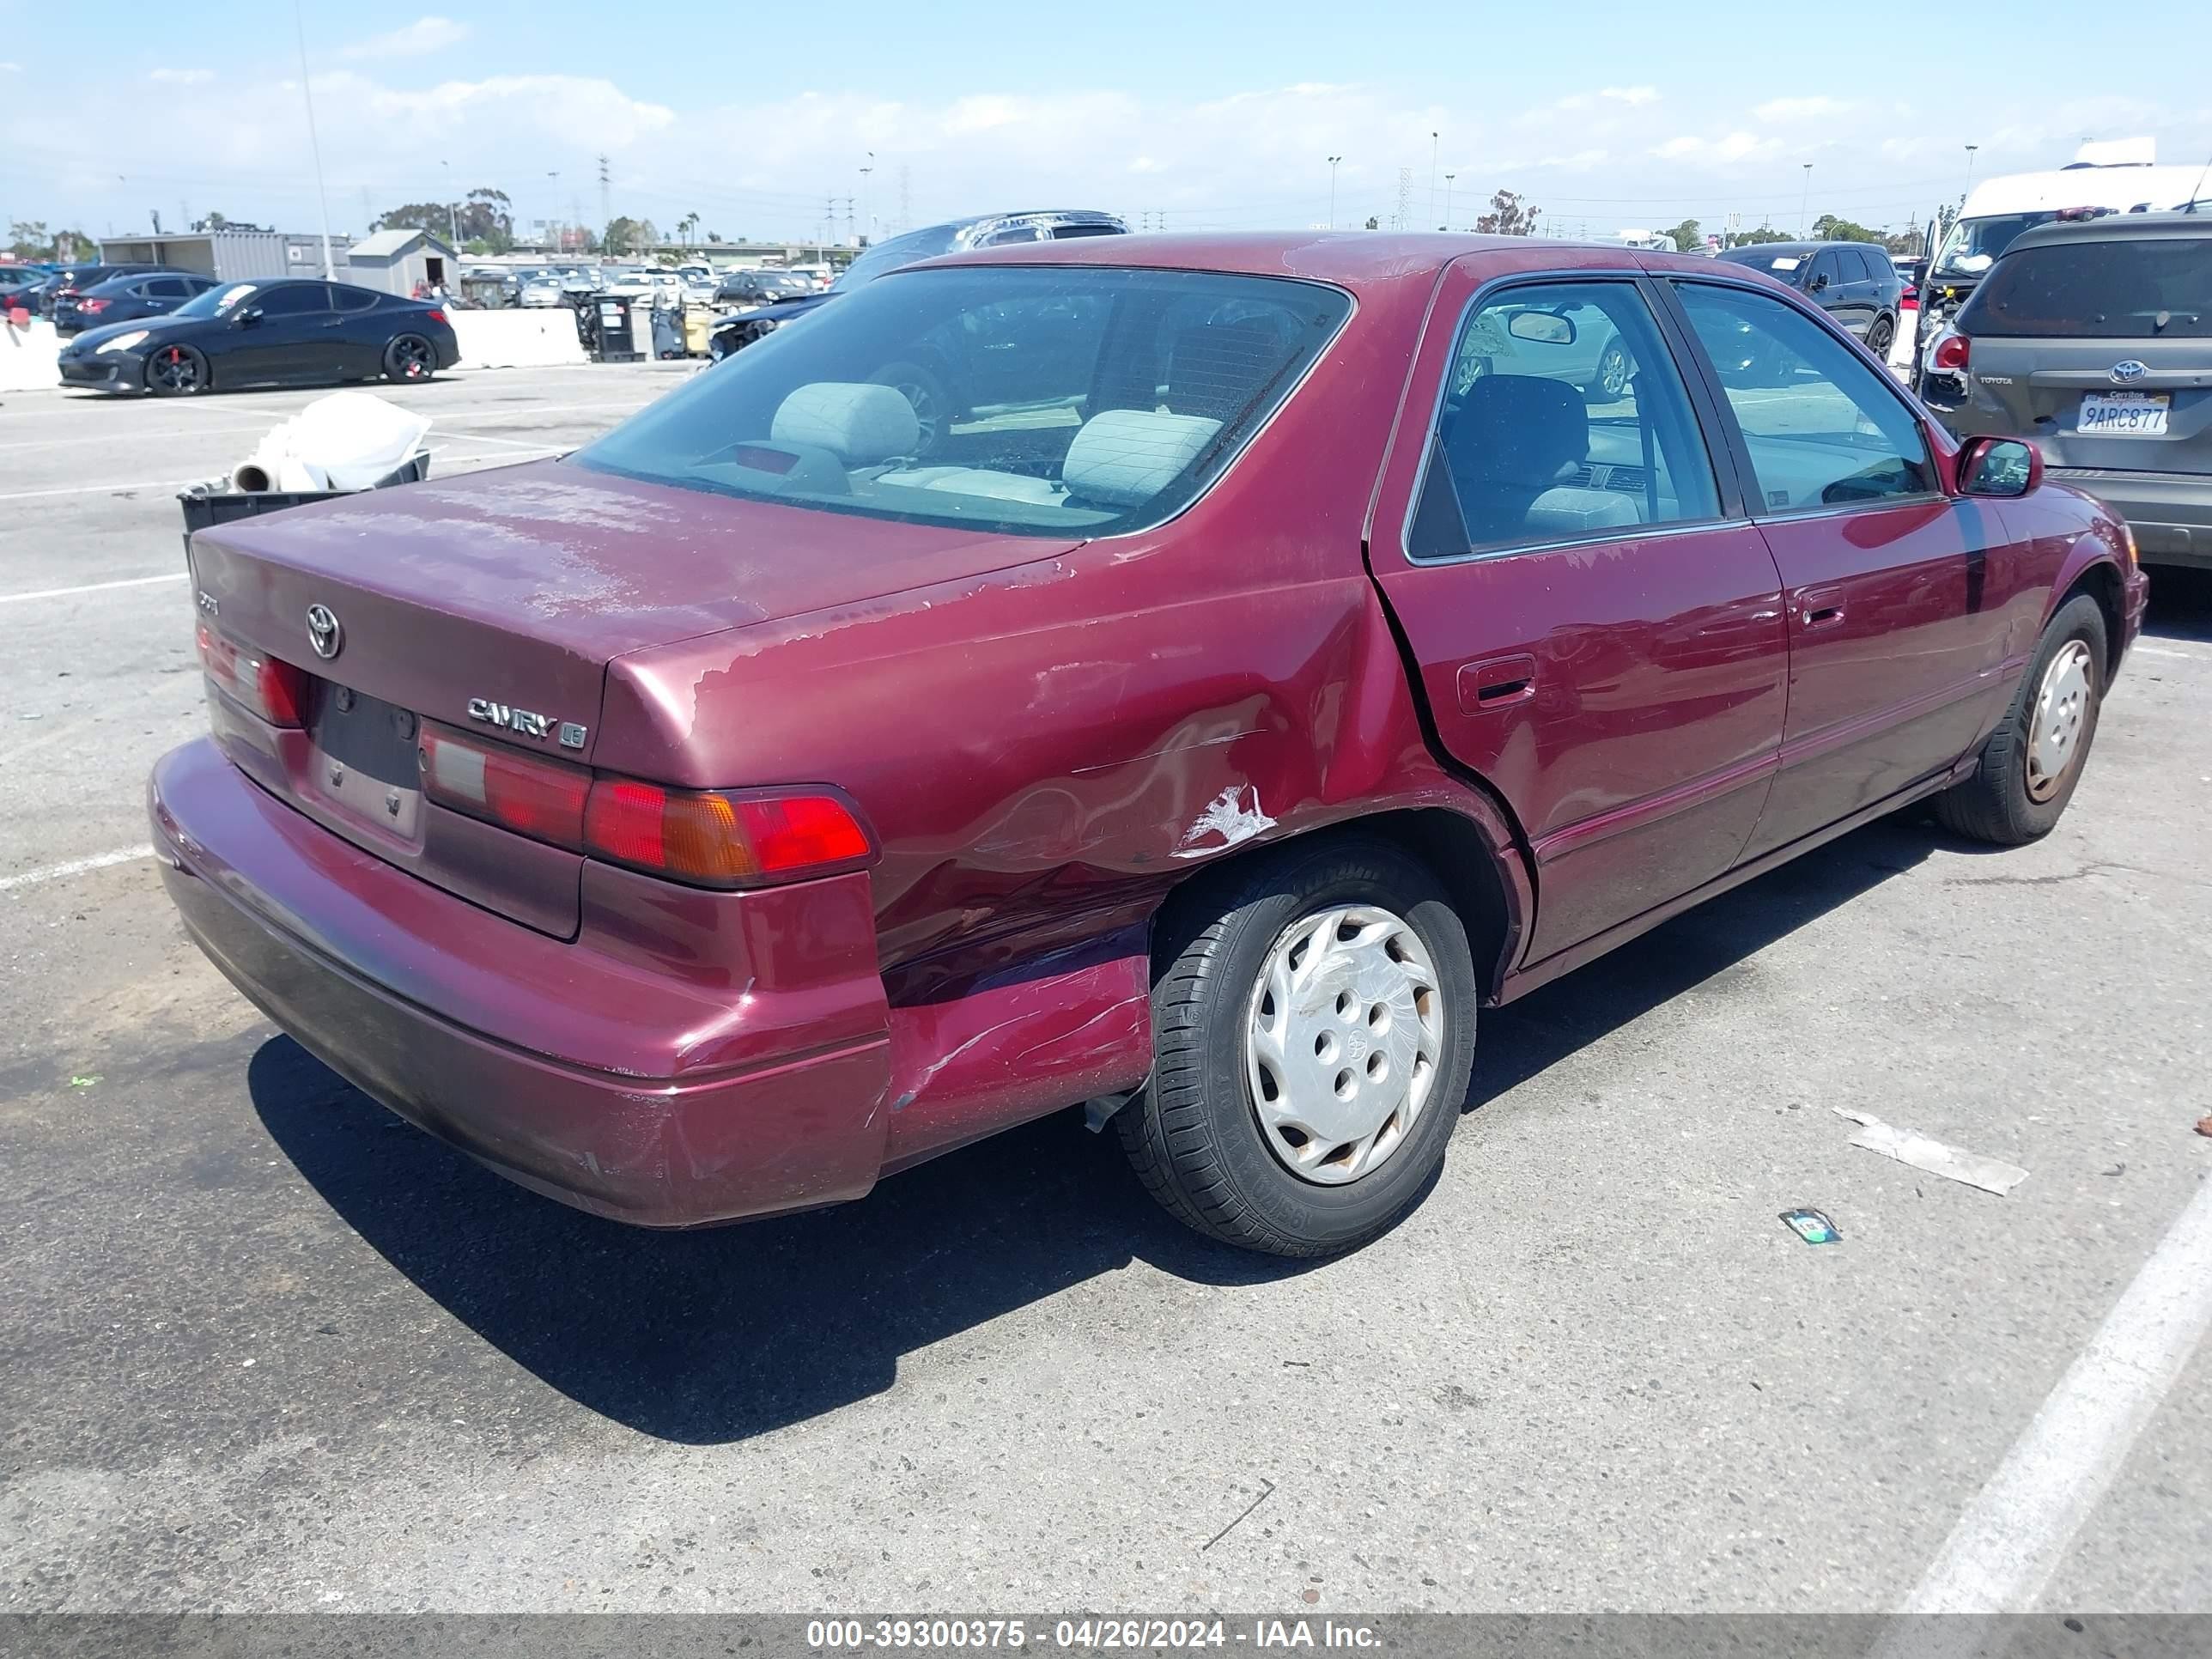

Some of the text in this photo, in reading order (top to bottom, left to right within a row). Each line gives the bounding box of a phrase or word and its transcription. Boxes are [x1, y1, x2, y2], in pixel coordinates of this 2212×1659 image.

[1980, 376, 2013, 385] TOYOTA
[2110, 391, 2145, 399] Cerritos
[2085, 407, 2165, 428] 9ARC877
[468, 698, 558, 738] CAMRY
